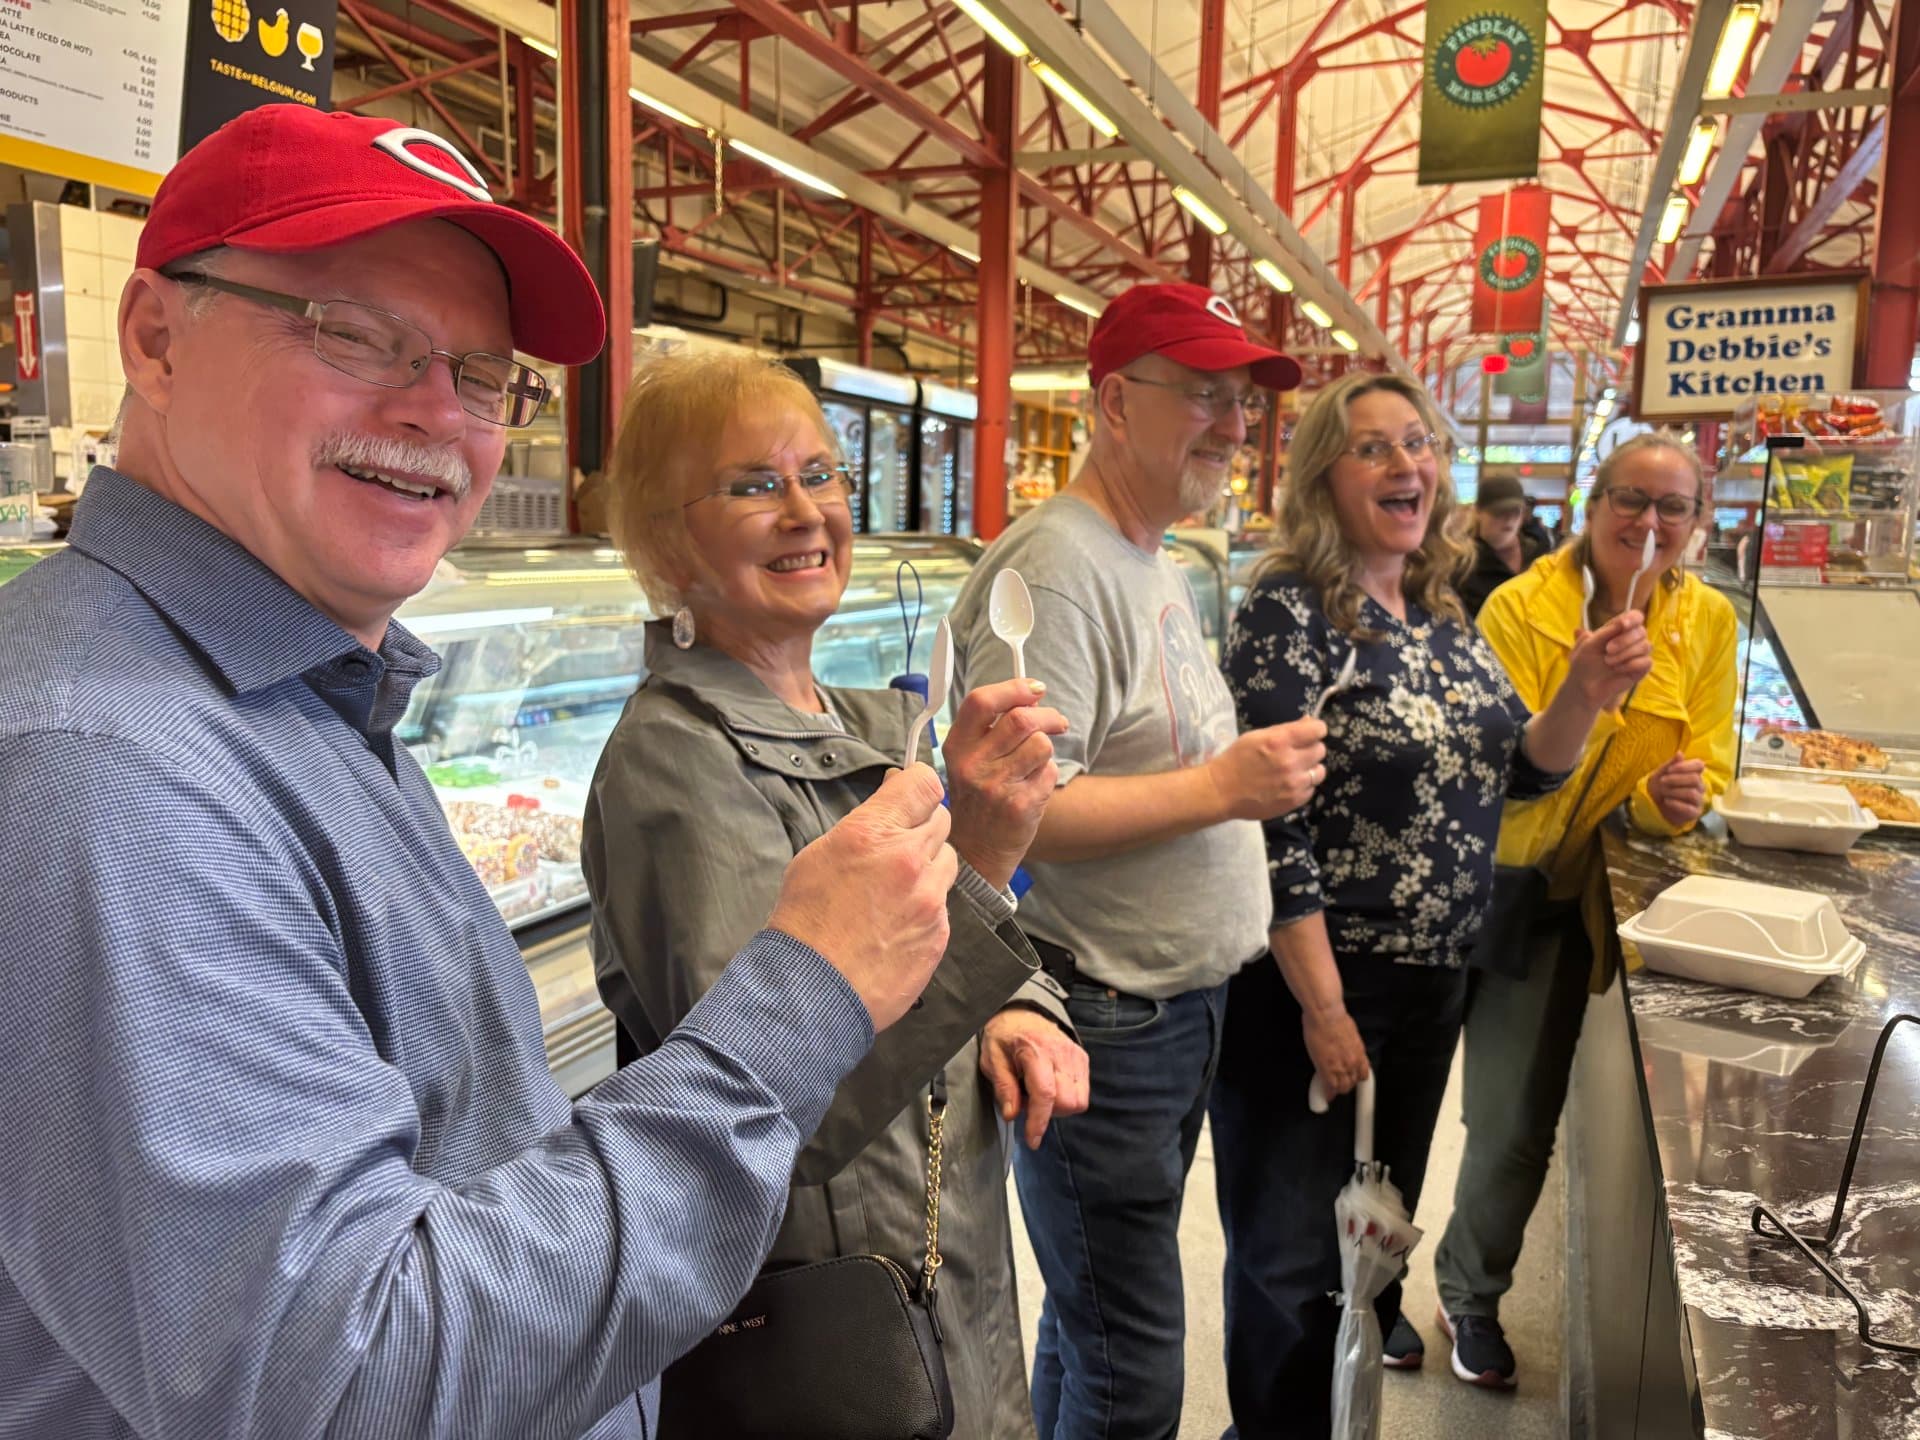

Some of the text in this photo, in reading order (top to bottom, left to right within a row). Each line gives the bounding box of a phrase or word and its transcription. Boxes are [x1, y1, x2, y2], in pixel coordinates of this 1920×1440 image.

[60, 38, 72, 48] OR
[1447, 19, 1527, 51] FINDLAY
[1446, 71, 1521, 104] MARKET
[1666, 303, 1835, 331] Gramma
[1666, 334, 1832, 365] Debbie's
[1668, 368, 1825, 397] Kitchen
